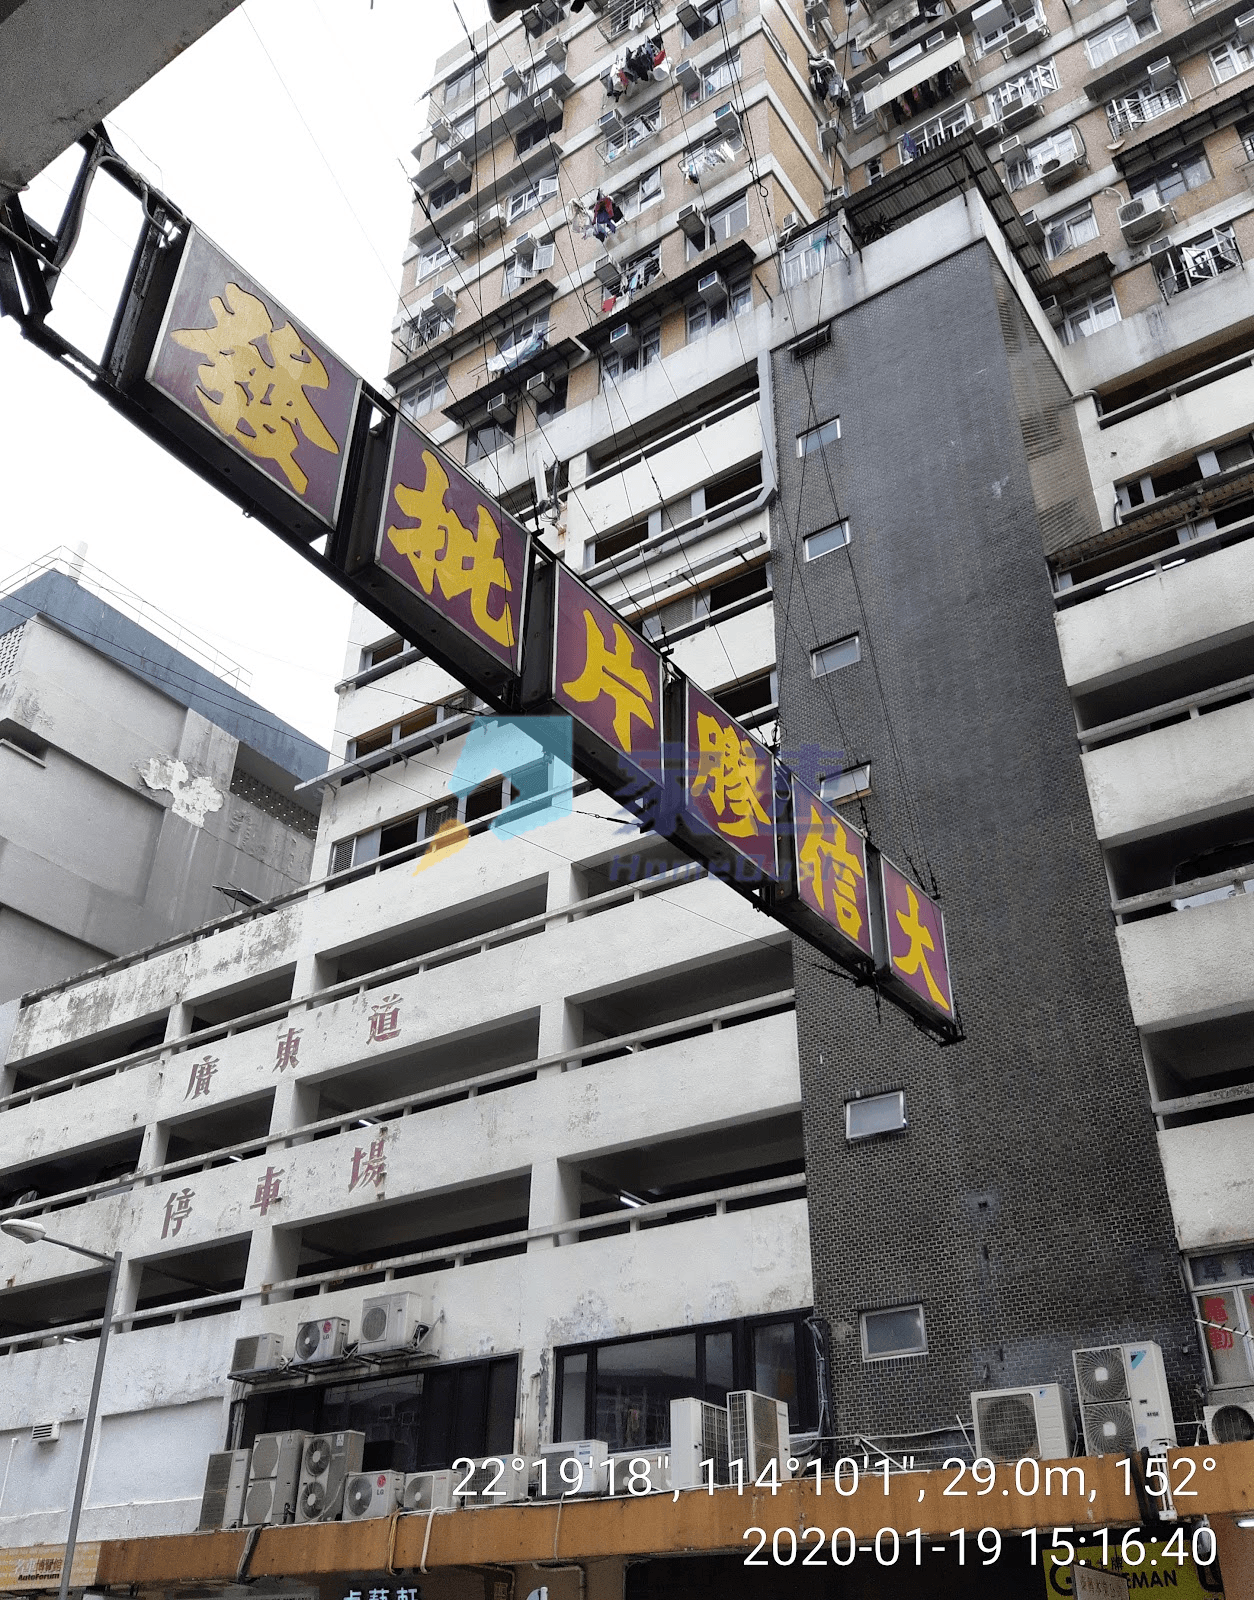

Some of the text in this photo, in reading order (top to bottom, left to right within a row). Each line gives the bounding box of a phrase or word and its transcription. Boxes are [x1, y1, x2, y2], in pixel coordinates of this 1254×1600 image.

[184, 994, 404, 1100] 廣東道
[160, 1139, 391, 1240] 停車場
